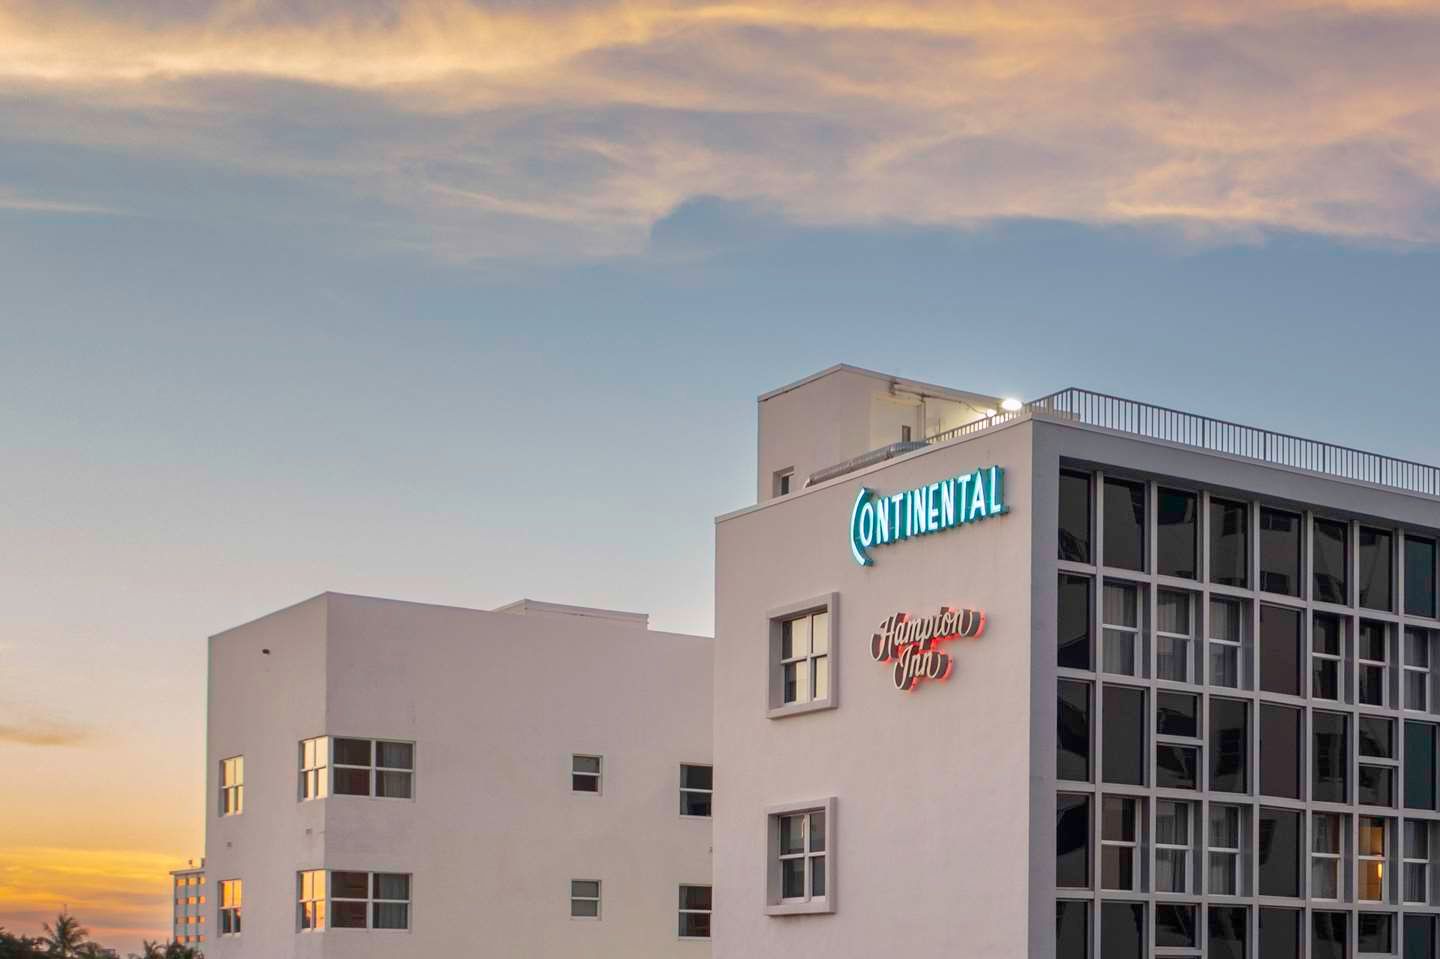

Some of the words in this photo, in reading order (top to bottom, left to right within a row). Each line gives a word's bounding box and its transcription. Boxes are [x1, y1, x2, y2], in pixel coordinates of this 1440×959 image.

[850, 465, 1006, 566] CONTINENTAL
[870, 607, 974, 661] Hampton
[893, 644, 942, 690] Inn
